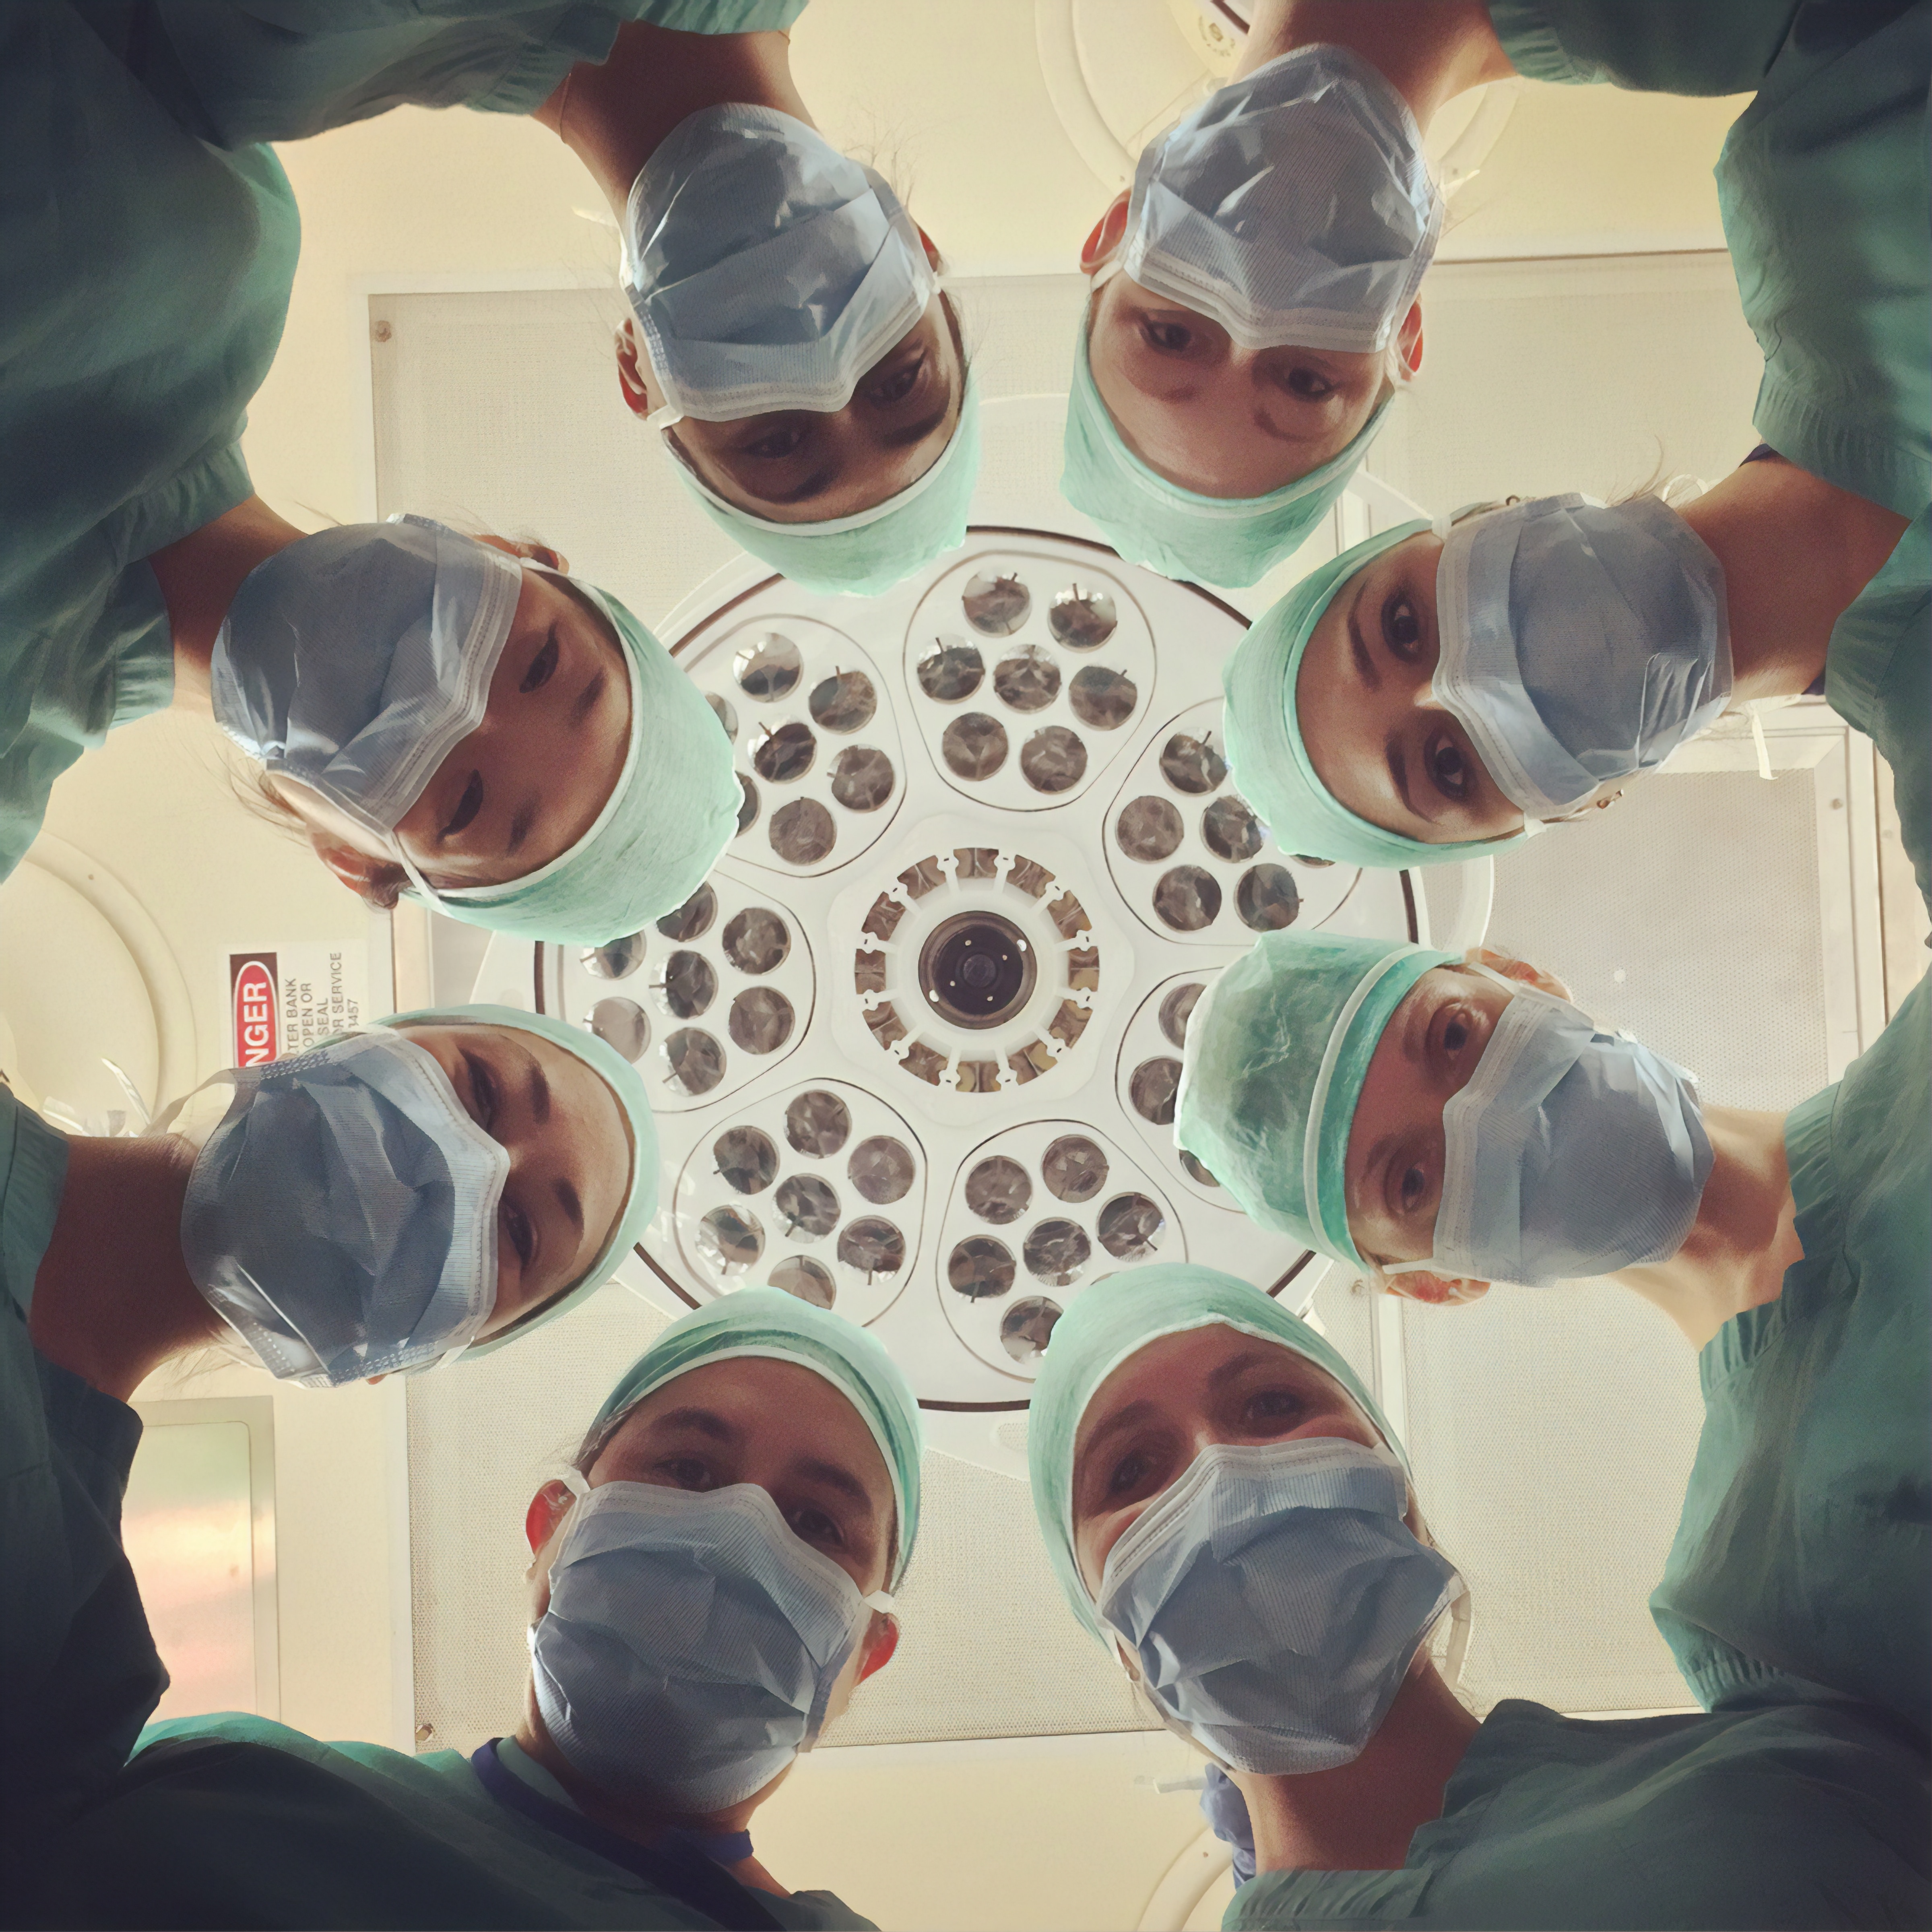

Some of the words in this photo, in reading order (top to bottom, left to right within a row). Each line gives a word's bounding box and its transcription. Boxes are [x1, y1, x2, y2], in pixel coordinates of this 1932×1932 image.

[285, 978, 298, 1018] BANK
[301, 983, 312, 1002] OR
[330, 953, 344, 1013] SERVICE
[243, 983, 269, 1067] NGER
[302, 1008, 314, 1046] OPEN
[317, 998, 329, 1035] SEAL
[287, 1024, 299, 1053] TER
